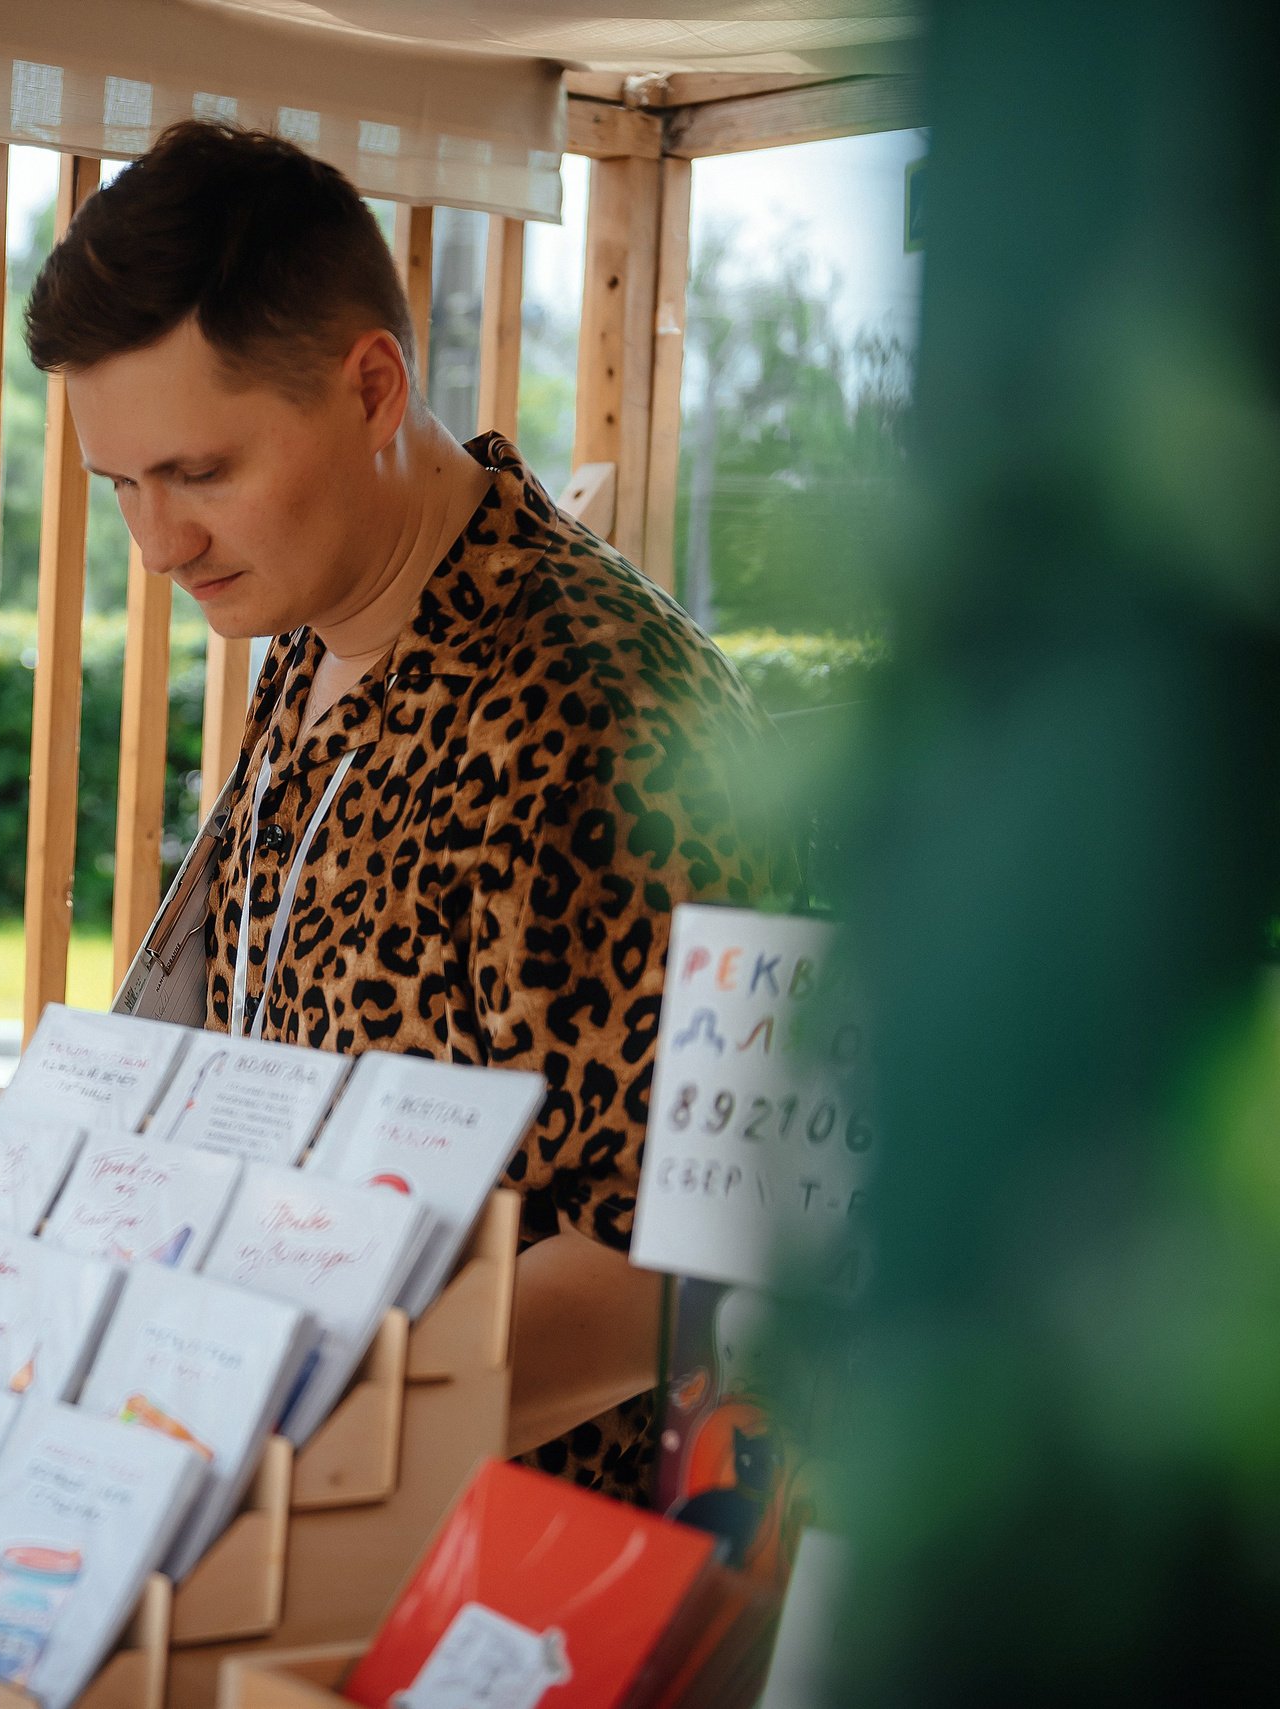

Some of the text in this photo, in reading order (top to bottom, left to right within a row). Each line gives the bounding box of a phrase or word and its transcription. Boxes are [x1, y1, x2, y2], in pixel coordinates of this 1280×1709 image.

[155, 942, 181, 993] НАИМОВАНИЕ
[680, 945, 816, 999] РЕКВ
[668, 1083, 874, 1154] 892106
